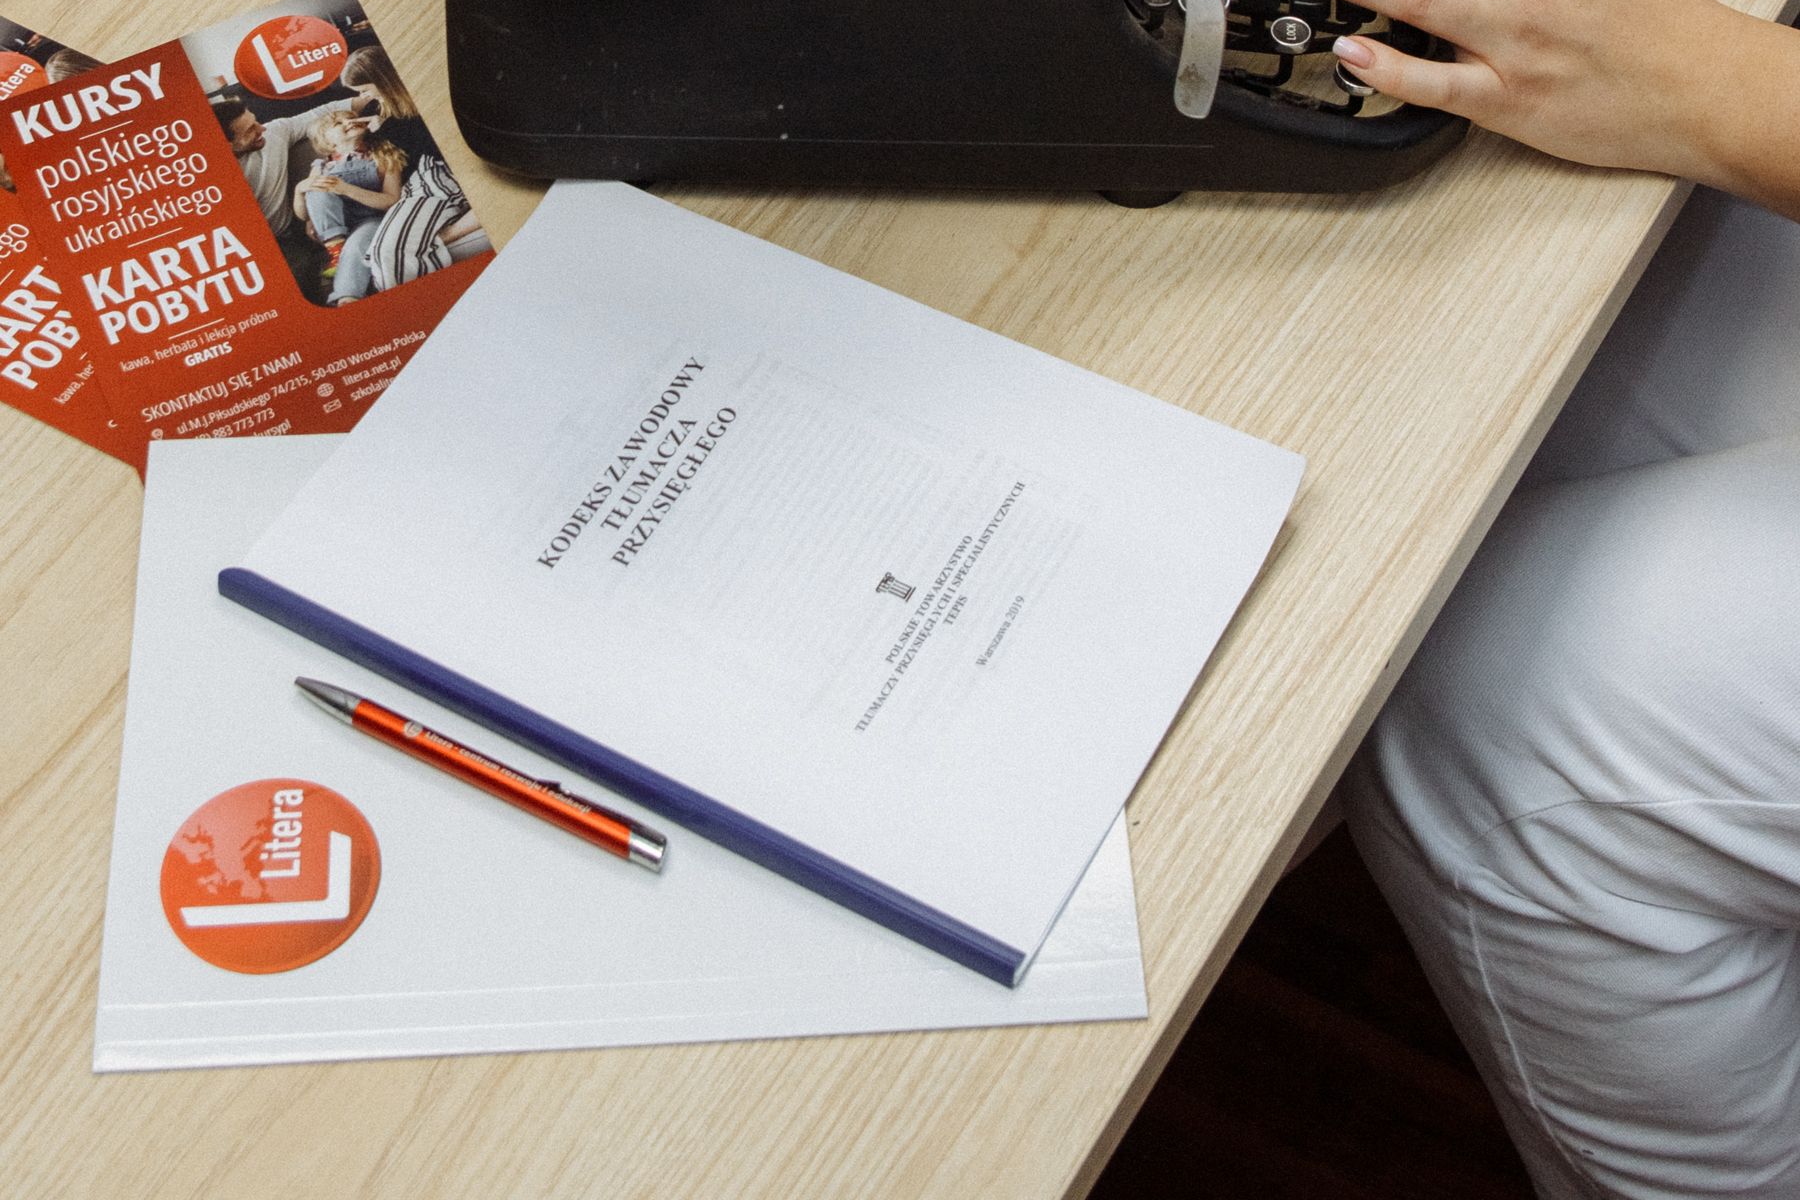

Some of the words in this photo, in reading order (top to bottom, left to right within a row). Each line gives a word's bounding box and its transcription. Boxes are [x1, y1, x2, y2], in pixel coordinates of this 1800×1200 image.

[287, 37, 342, 70] Litera
[1286, 23, 1297, 41] LOCK
[10, 61, 169, 145] KURSY
[34, 117, 194, 198] polskiego
[49, 151, 209, 223] rosyjskiego
[64, 184, 224, 254] ukraińskiego
[81, 226, 253, 311] KARTA
[98, 260, 266, 346] POBYTU
[0, 264, 63, 358] ART
[119, 354, 155, 374] kawa,
[153, 339, 198, 360] herbata
[205, 323, 238, 346] lekcja
[238, 308, 279, 334] próbna
[141, 380, 229, 423] SKONTAKTUJ
[229, 370, 254, 392] SIĘ
[252, 366, 263, 381] Z
[262, 351, 303, 377] NAMI
[184, 341, 233, 368] GRATIS
[270, 372, 310, 399] 74/215,
[312, 357, 348, 383] 50-020
[212, 424, 233, 439] 883
[233, 415, 255, 433] 773
[254, 407, 276, 426] 773
[536, 482, 614, 570] KODEKS
[604, 356, 706, 483] ZAWODOWY
[601, 416, 697, 534] TŁUMACZA
[610, 405, 738, 568] PRZYSIĘGŁEGO
[855, 674, 899, 733] TŁUMACZY
[894, 594, 953, 676] PRZYSIĘGŁYCH
[950, 482, 1026, 588] SPECJALISTYCZNYCH
[885, 618, 919, 664] POLSKIE
[914, 535, 974, 617] TOWARZYSTWO
[944, 595, 968, 626] TEPIS
[976, 621, 1013, 668] Warszawa
[1006, 595, 1026, 621] 2019
[459, 749, 500, 770] centrum
[259, 788, 305, 879] Litera
